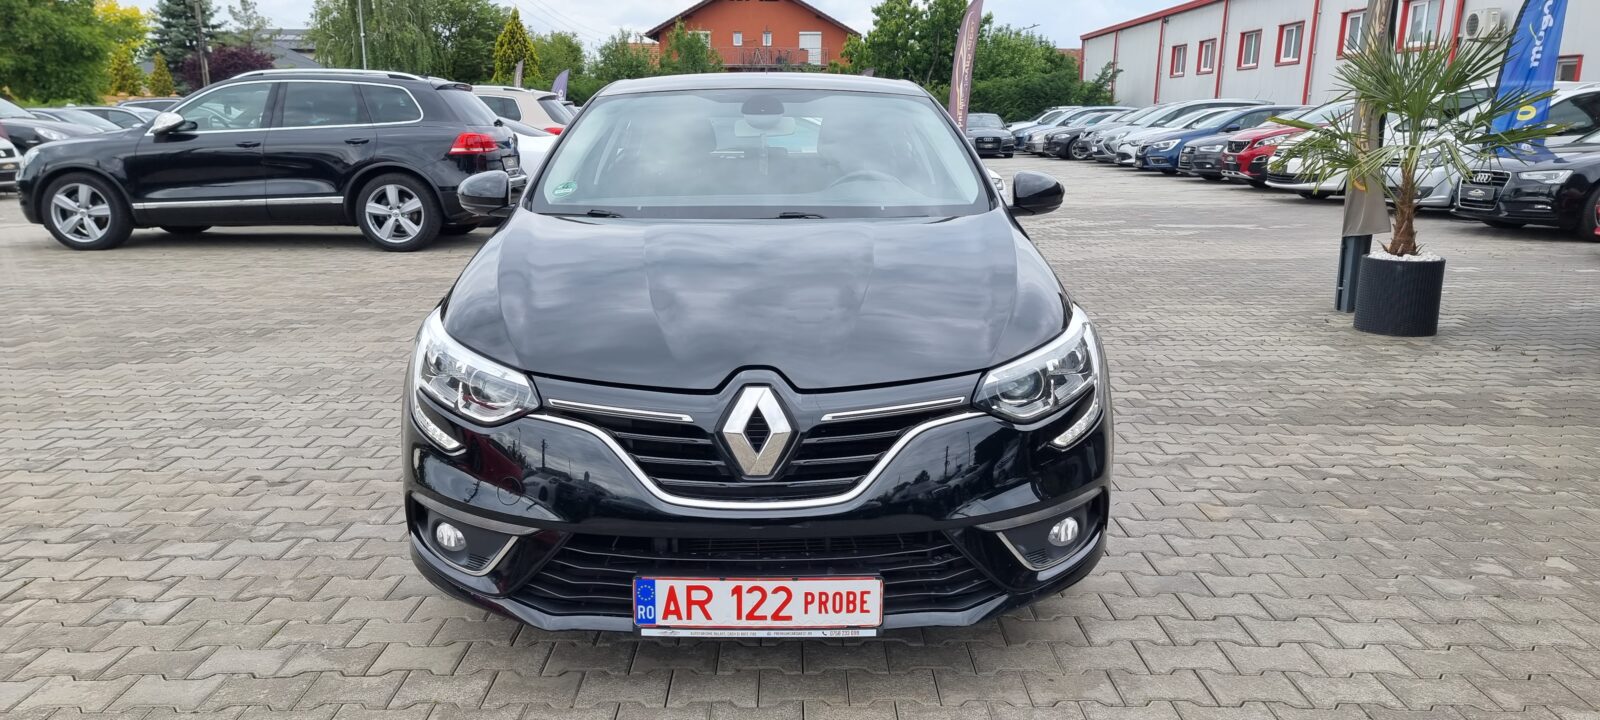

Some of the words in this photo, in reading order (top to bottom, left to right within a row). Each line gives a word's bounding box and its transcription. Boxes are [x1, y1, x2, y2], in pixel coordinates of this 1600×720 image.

[637, 605, 655, 619] RO
[662, 585, 713, 620] AR
[730, 585, 793, 620] 122
[804, 591, 871, 614] PROBE
